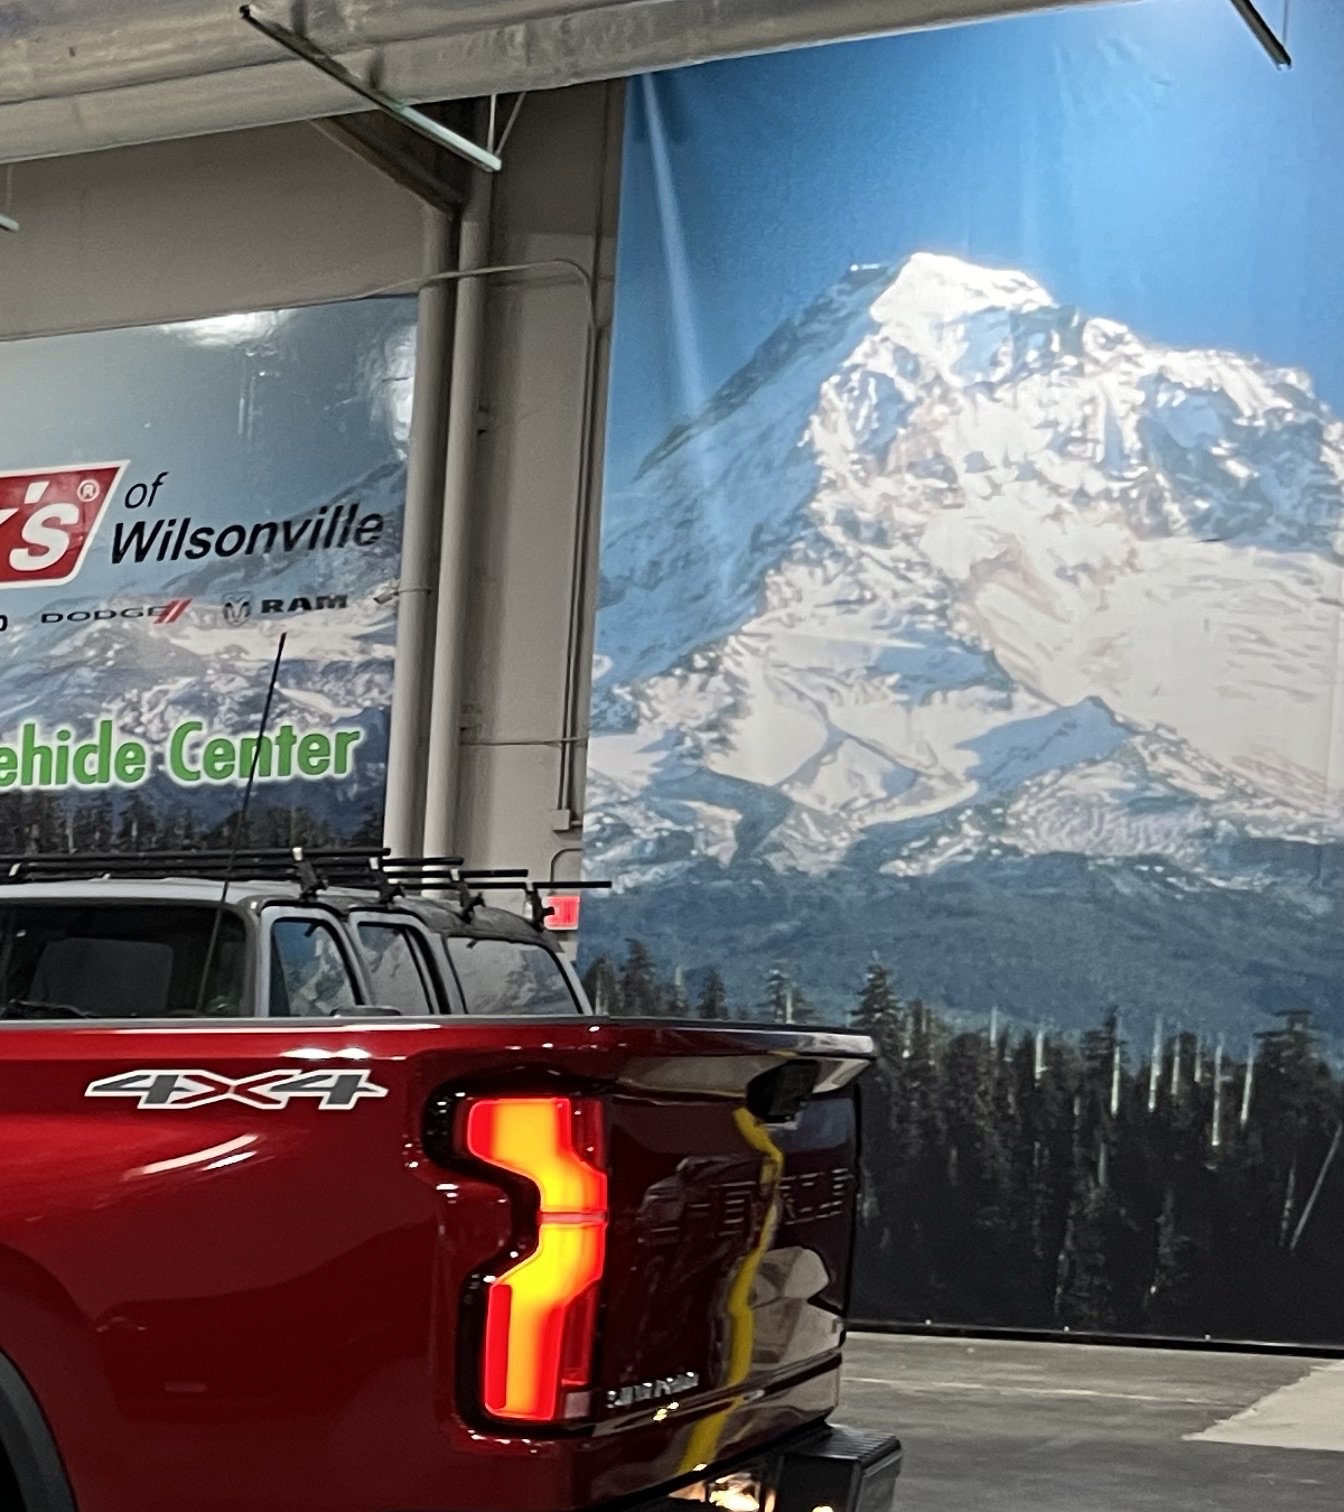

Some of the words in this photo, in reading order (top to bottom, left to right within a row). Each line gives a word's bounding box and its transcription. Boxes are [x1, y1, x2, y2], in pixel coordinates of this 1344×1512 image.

[124, 472, 168, 509] of
[111, 503, 385, 564] Wilsonville
[40, 605, 170, 623] DODGE
[262, 595, 348, 614] RAM
[169, 720, 361, 782] Center
